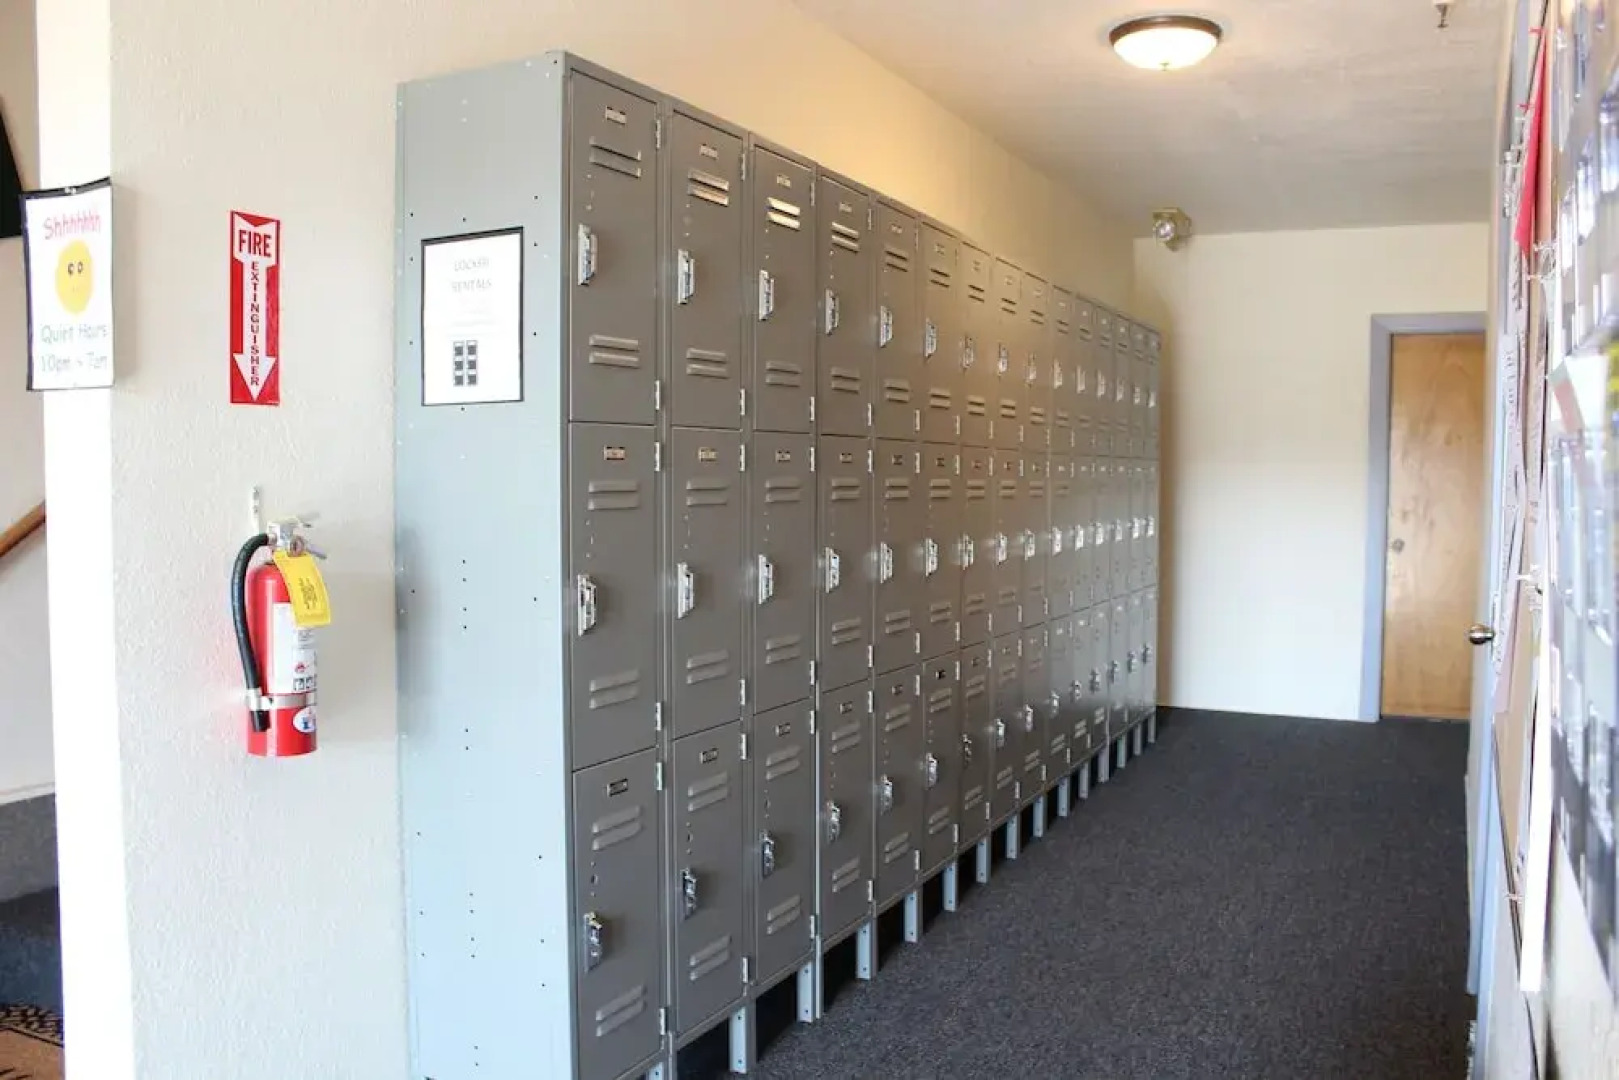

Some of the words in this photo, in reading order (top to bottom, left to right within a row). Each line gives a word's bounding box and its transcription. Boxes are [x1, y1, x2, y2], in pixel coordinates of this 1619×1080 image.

[238, 229, 272, 258] FIRE
[454, 256, 490, 272] LOCKER
[451, 278, 492, 293] RENTALS
[41, 324, 74, 344] Quiet
[79, 323, 107, 339] Hours
[250, 260, 260, 387] EXTINGUISHER
[41, 354, 71, 374] 10pm
[85, 351, 108, 370] 7am
